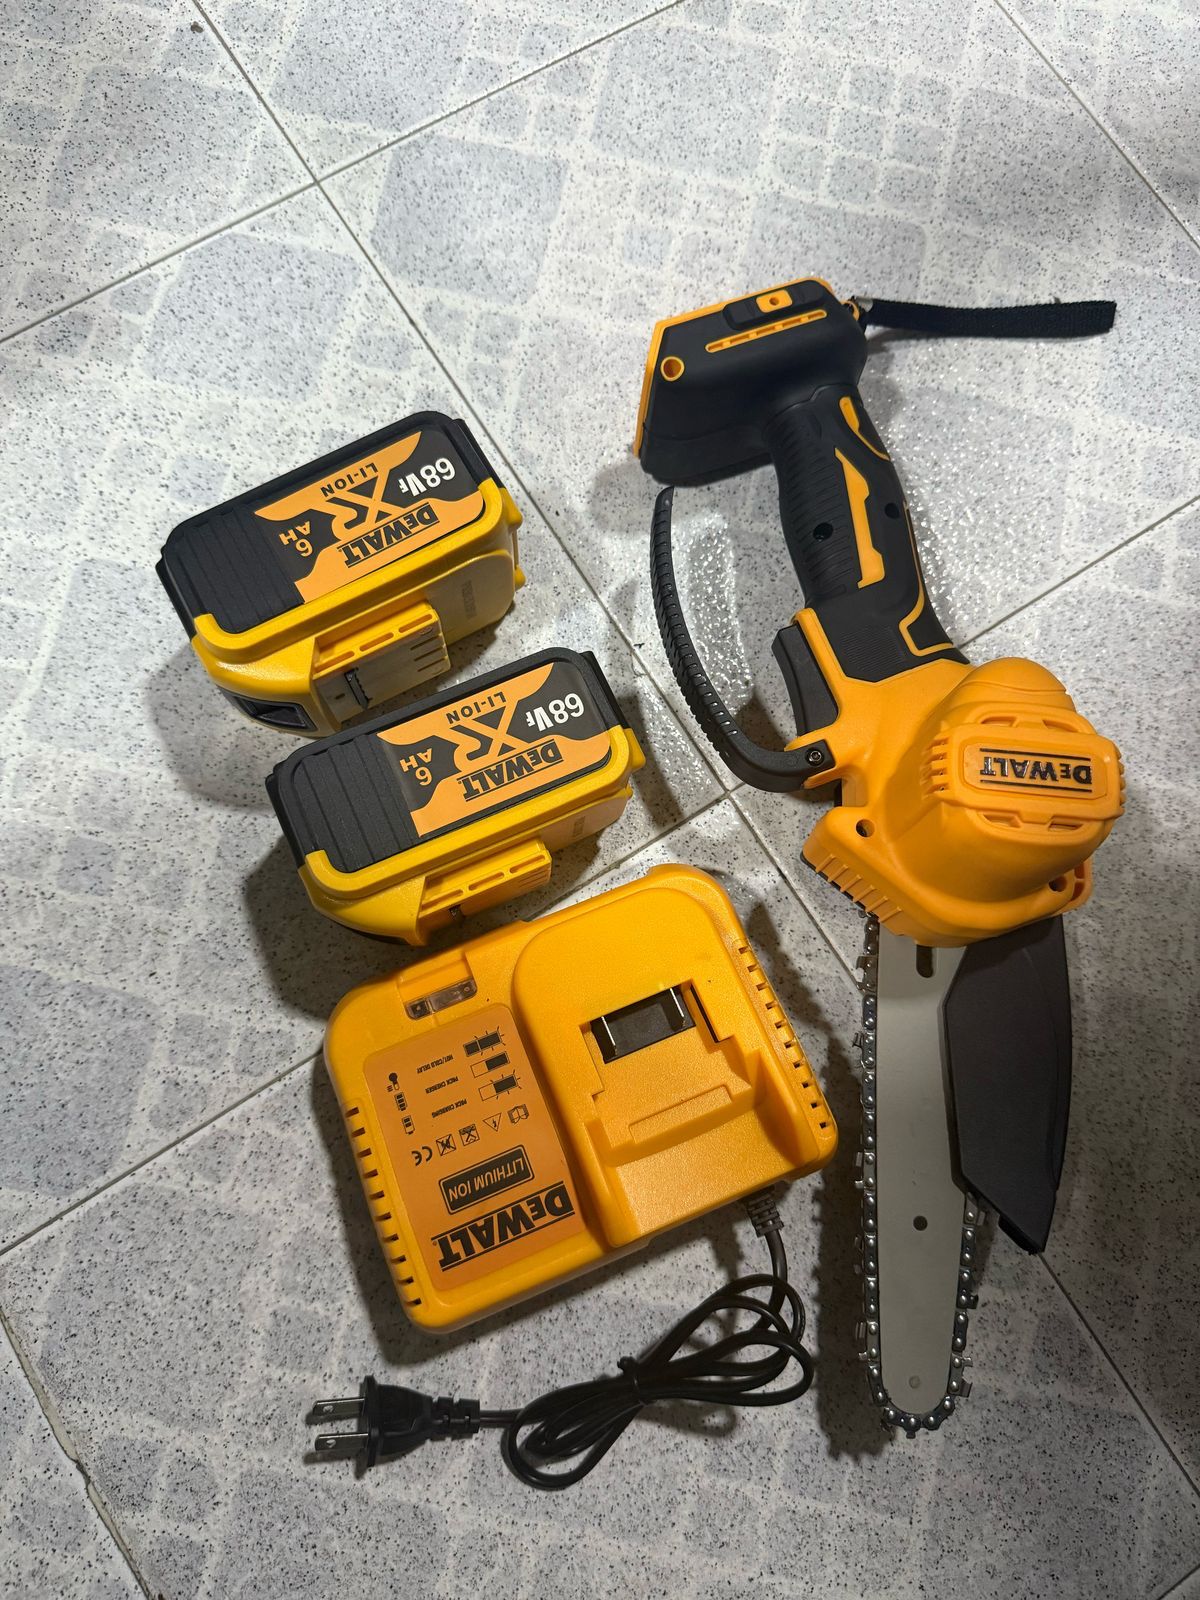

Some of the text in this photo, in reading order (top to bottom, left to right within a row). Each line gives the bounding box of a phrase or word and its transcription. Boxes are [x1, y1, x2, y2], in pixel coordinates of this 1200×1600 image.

[320, 463, 379, 497] LI-ION
[279, 520, 311, 546] AH
[295, 538, 313, 557] 6
[446, 691, 507, 725] LI-ION
[400, 748, 432, 772] AH
[415, 766, 433, 786] 6
[448, 1157, 525, 1201] LITHIUM ION
